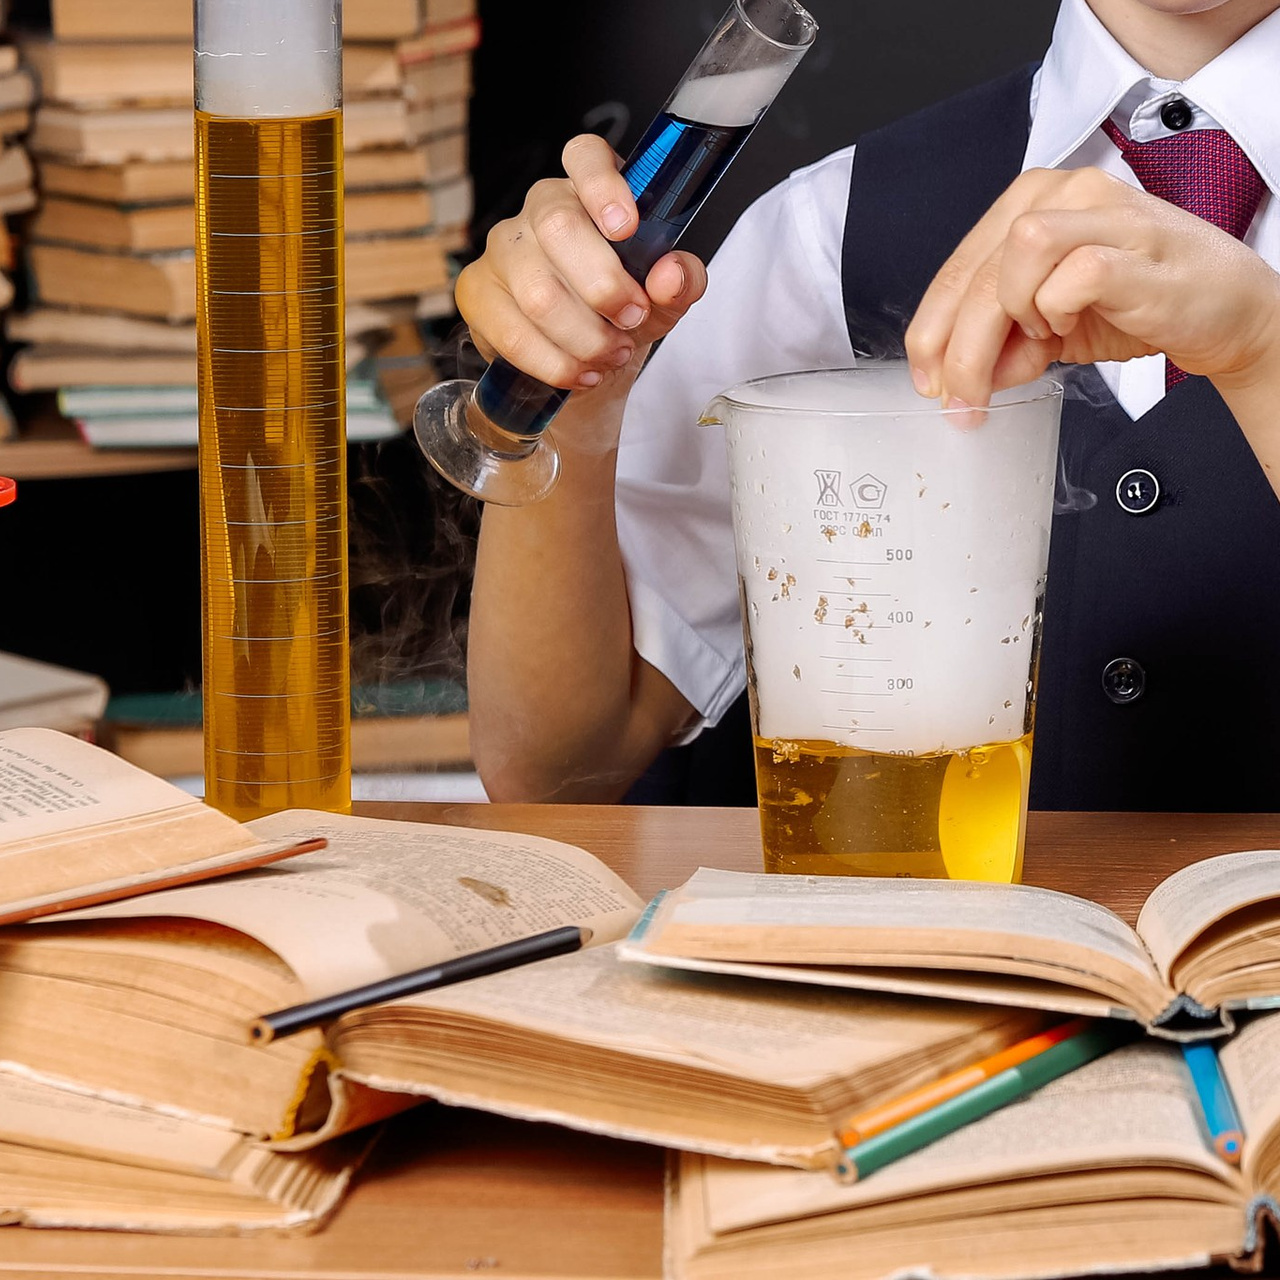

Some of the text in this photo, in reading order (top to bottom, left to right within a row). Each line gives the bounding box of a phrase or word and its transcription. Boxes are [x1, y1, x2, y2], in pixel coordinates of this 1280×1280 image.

[813, 509, 839, 521] ГОСТ
[886, 548, 914, 562] 500
[887, 611, 914, 624] 400
[887, 677, 914, 691] 300
